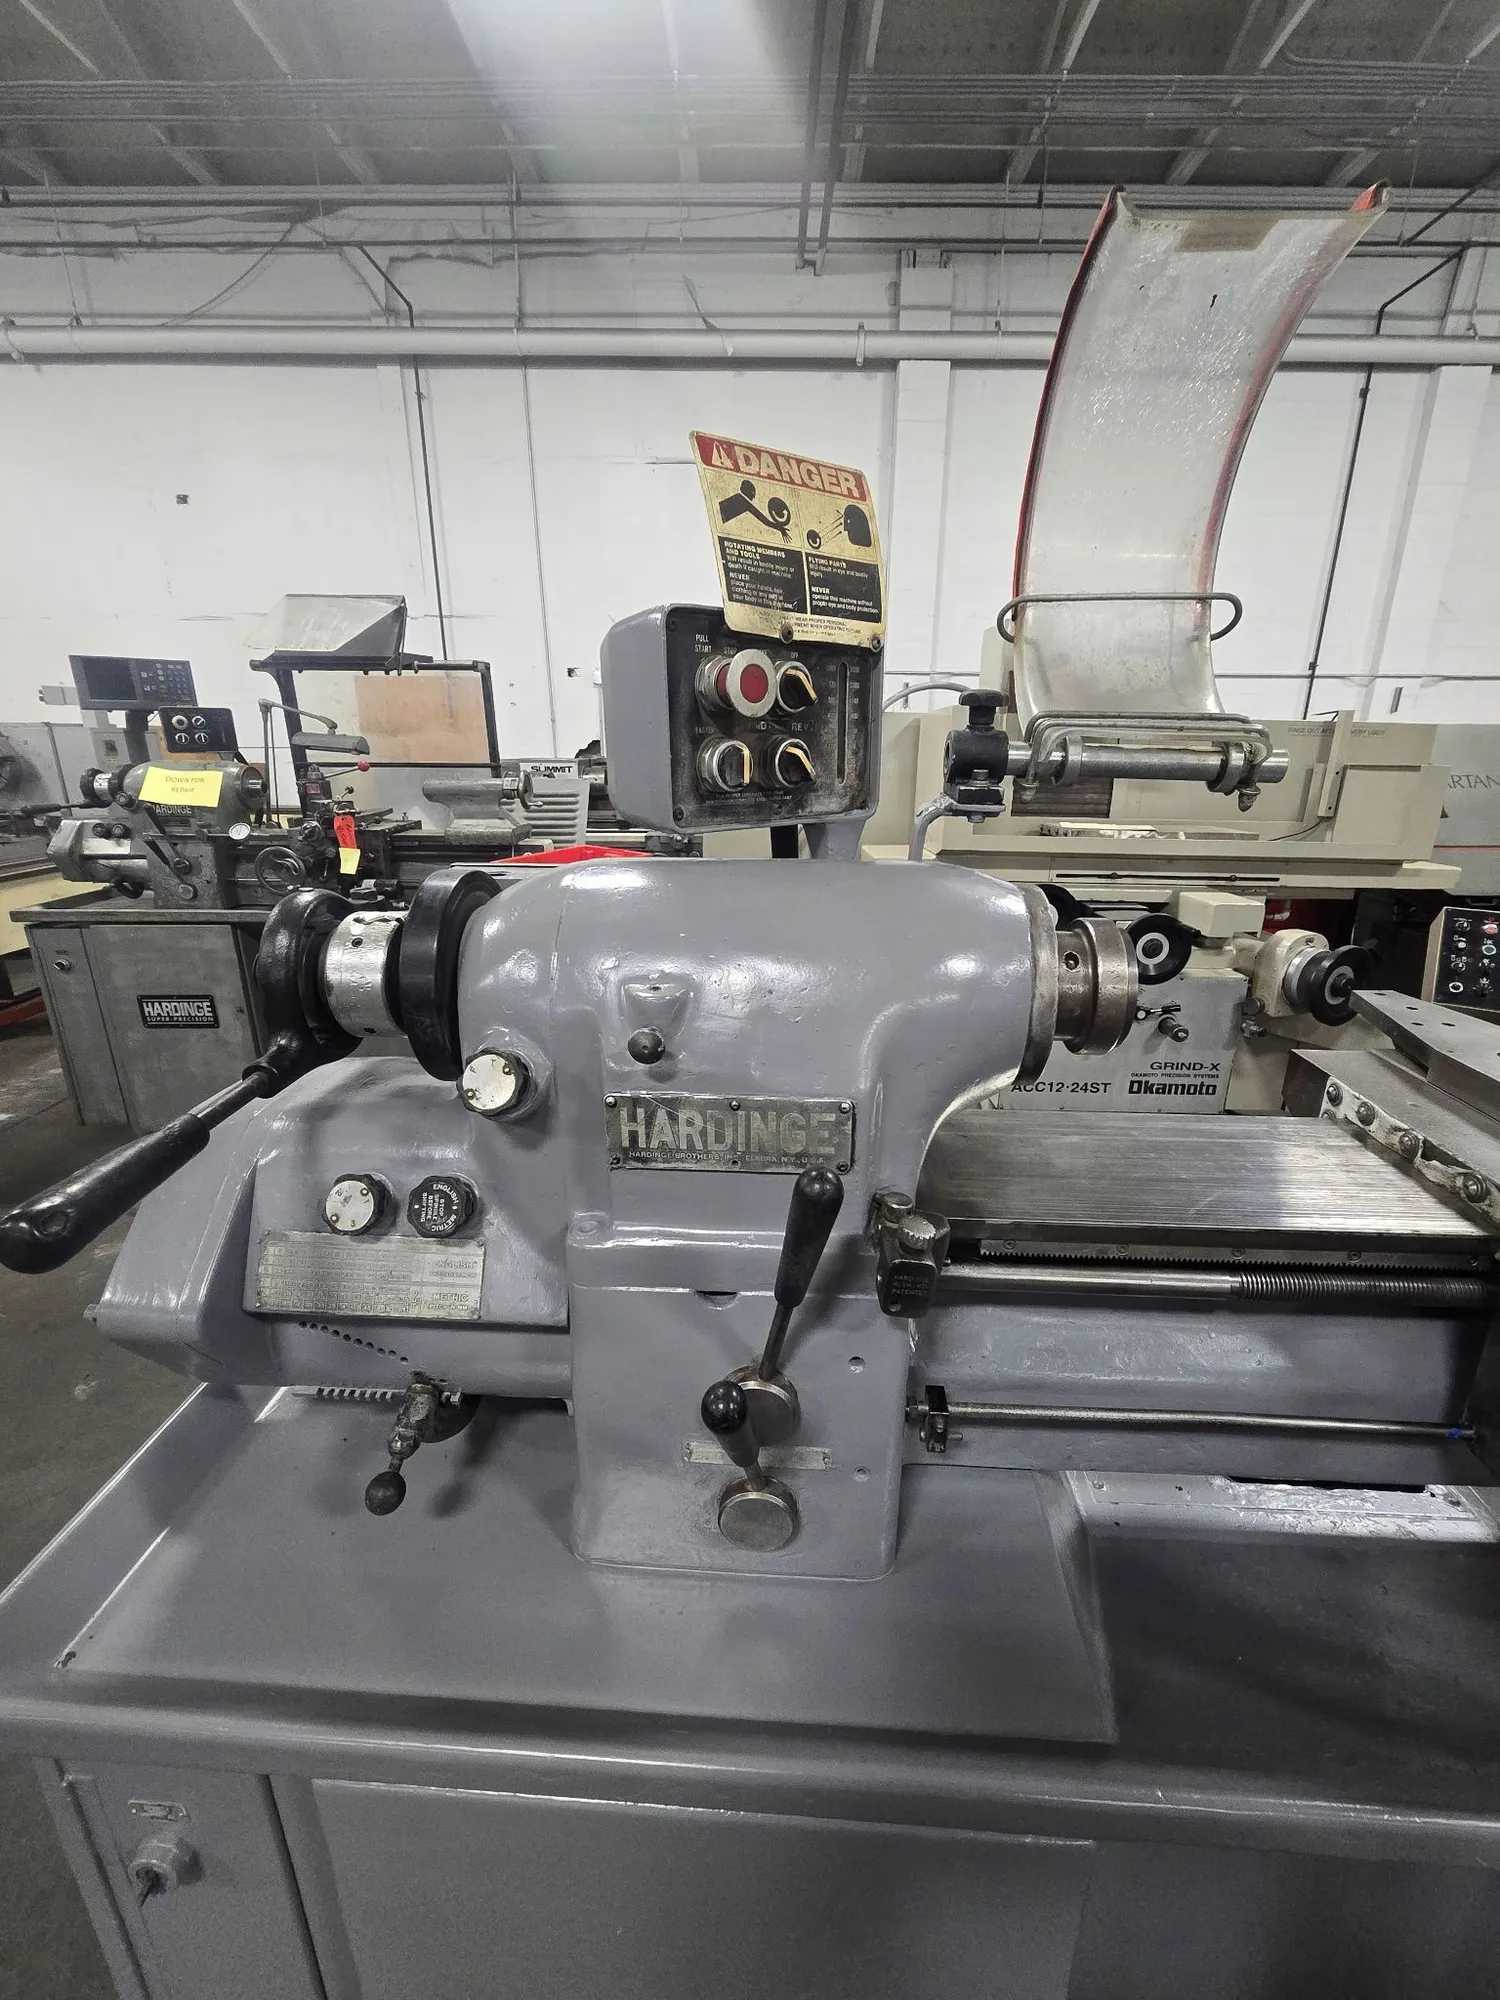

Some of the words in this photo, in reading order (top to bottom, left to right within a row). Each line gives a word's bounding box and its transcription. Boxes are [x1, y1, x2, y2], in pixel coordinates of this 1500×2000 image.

[734, 446, 863, 498] DANGER
[723, 540, 755, 552] ROTATING
[756, 546, 785, 558] MEMBERS
[725, 547, 738, 555] AND
[739, 550, 760, 559] TOOLS
[808, 556, 827, 565] FLYING
[828, 559, 846, 568] PARTS
[729, 571, 749, 580] NEVER
[811, 586, 829, 594] NEVER
[695, 634, 709, 643] PULL
[695, 645, 712, 653] START
[531, 765, 573, 774] SUMMIT
[143, 1002, 213, 1016] HARDINGE
[1150, 1062, 1220, 1071] GRIND-X
[1128, 1080, 1217, 1096] Okamoto
[620, 1107, 836, 1153] HARDINGE
[433, 1184, 459, 1204] ENGLISH
[420, 1192, 428, 1223] SHIFTING
[431, 1214, 457, 1232] METRIC
